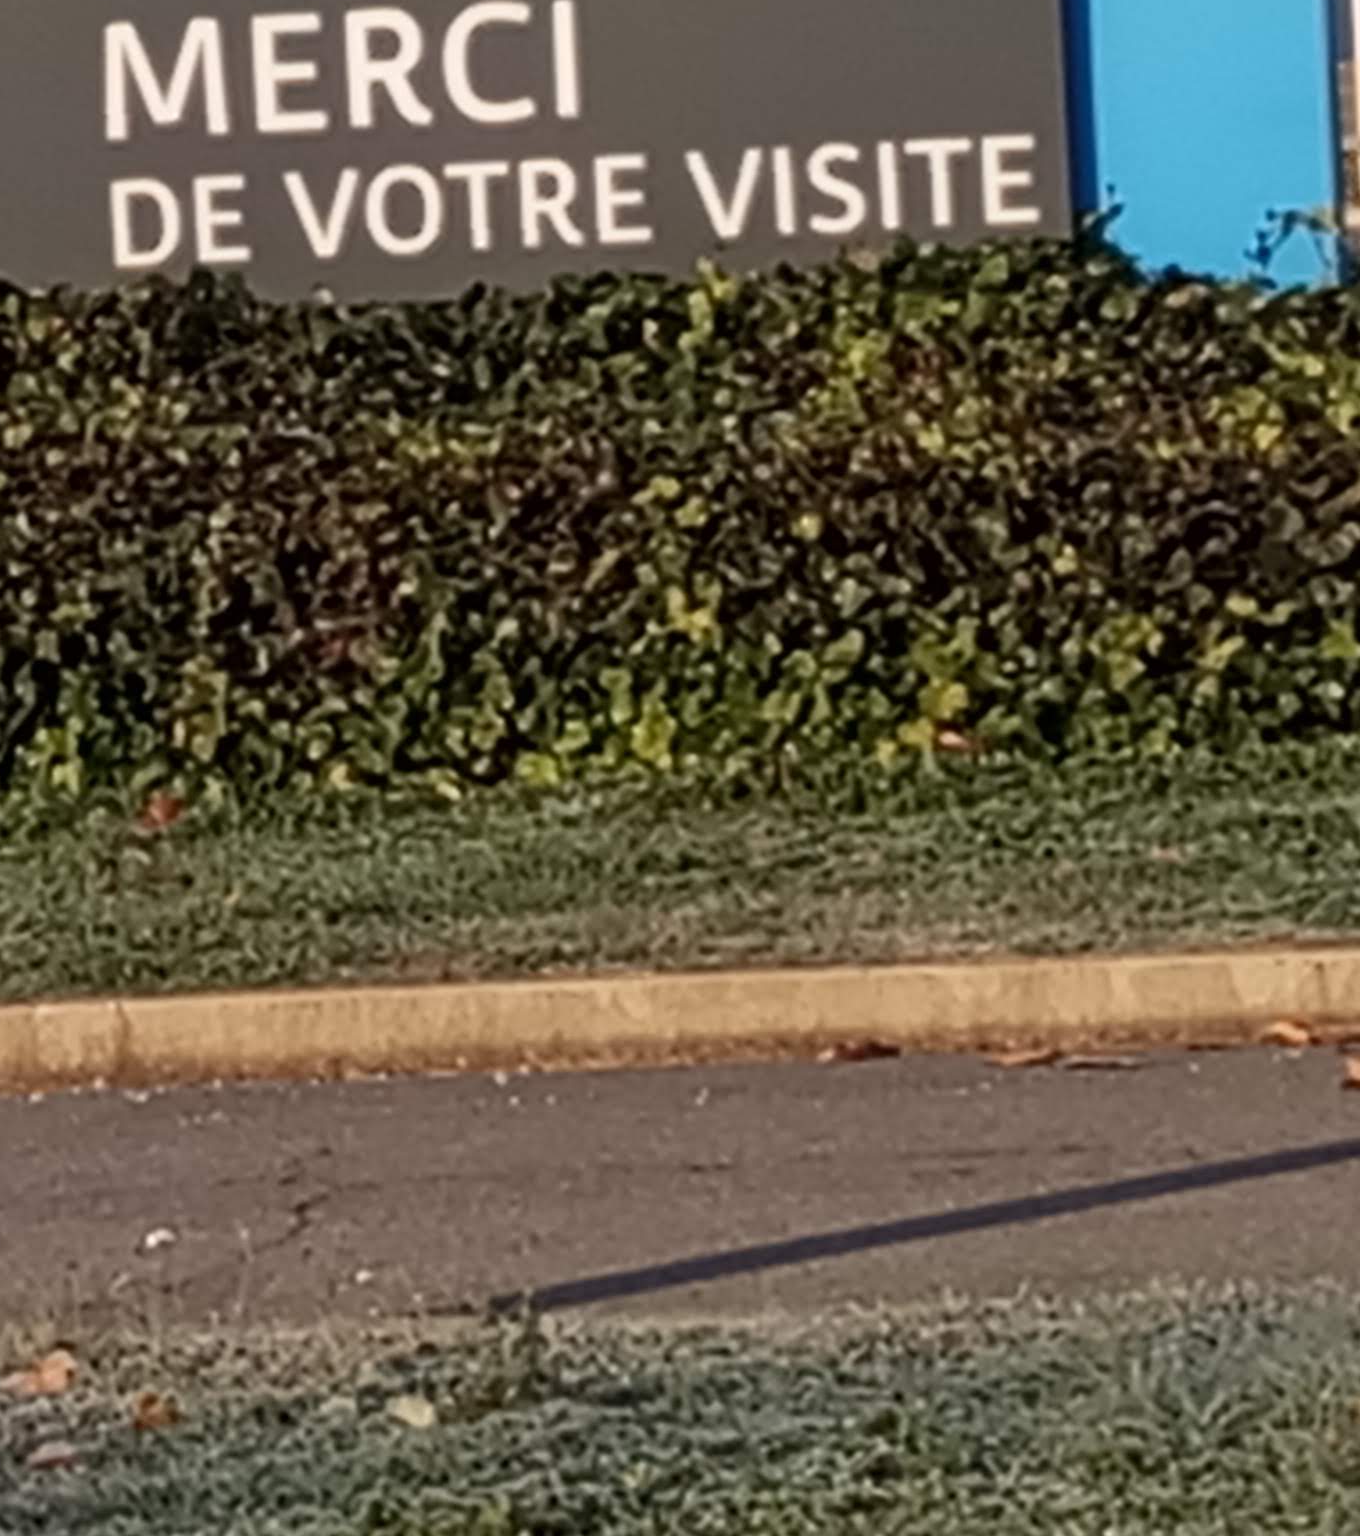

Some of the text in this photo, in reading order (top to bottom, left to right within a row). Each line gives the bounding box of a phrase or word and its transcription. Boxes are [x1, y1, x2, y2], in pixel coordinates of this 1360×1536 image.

[109, 133, 1041, 268] DE VOTRE VISITE
